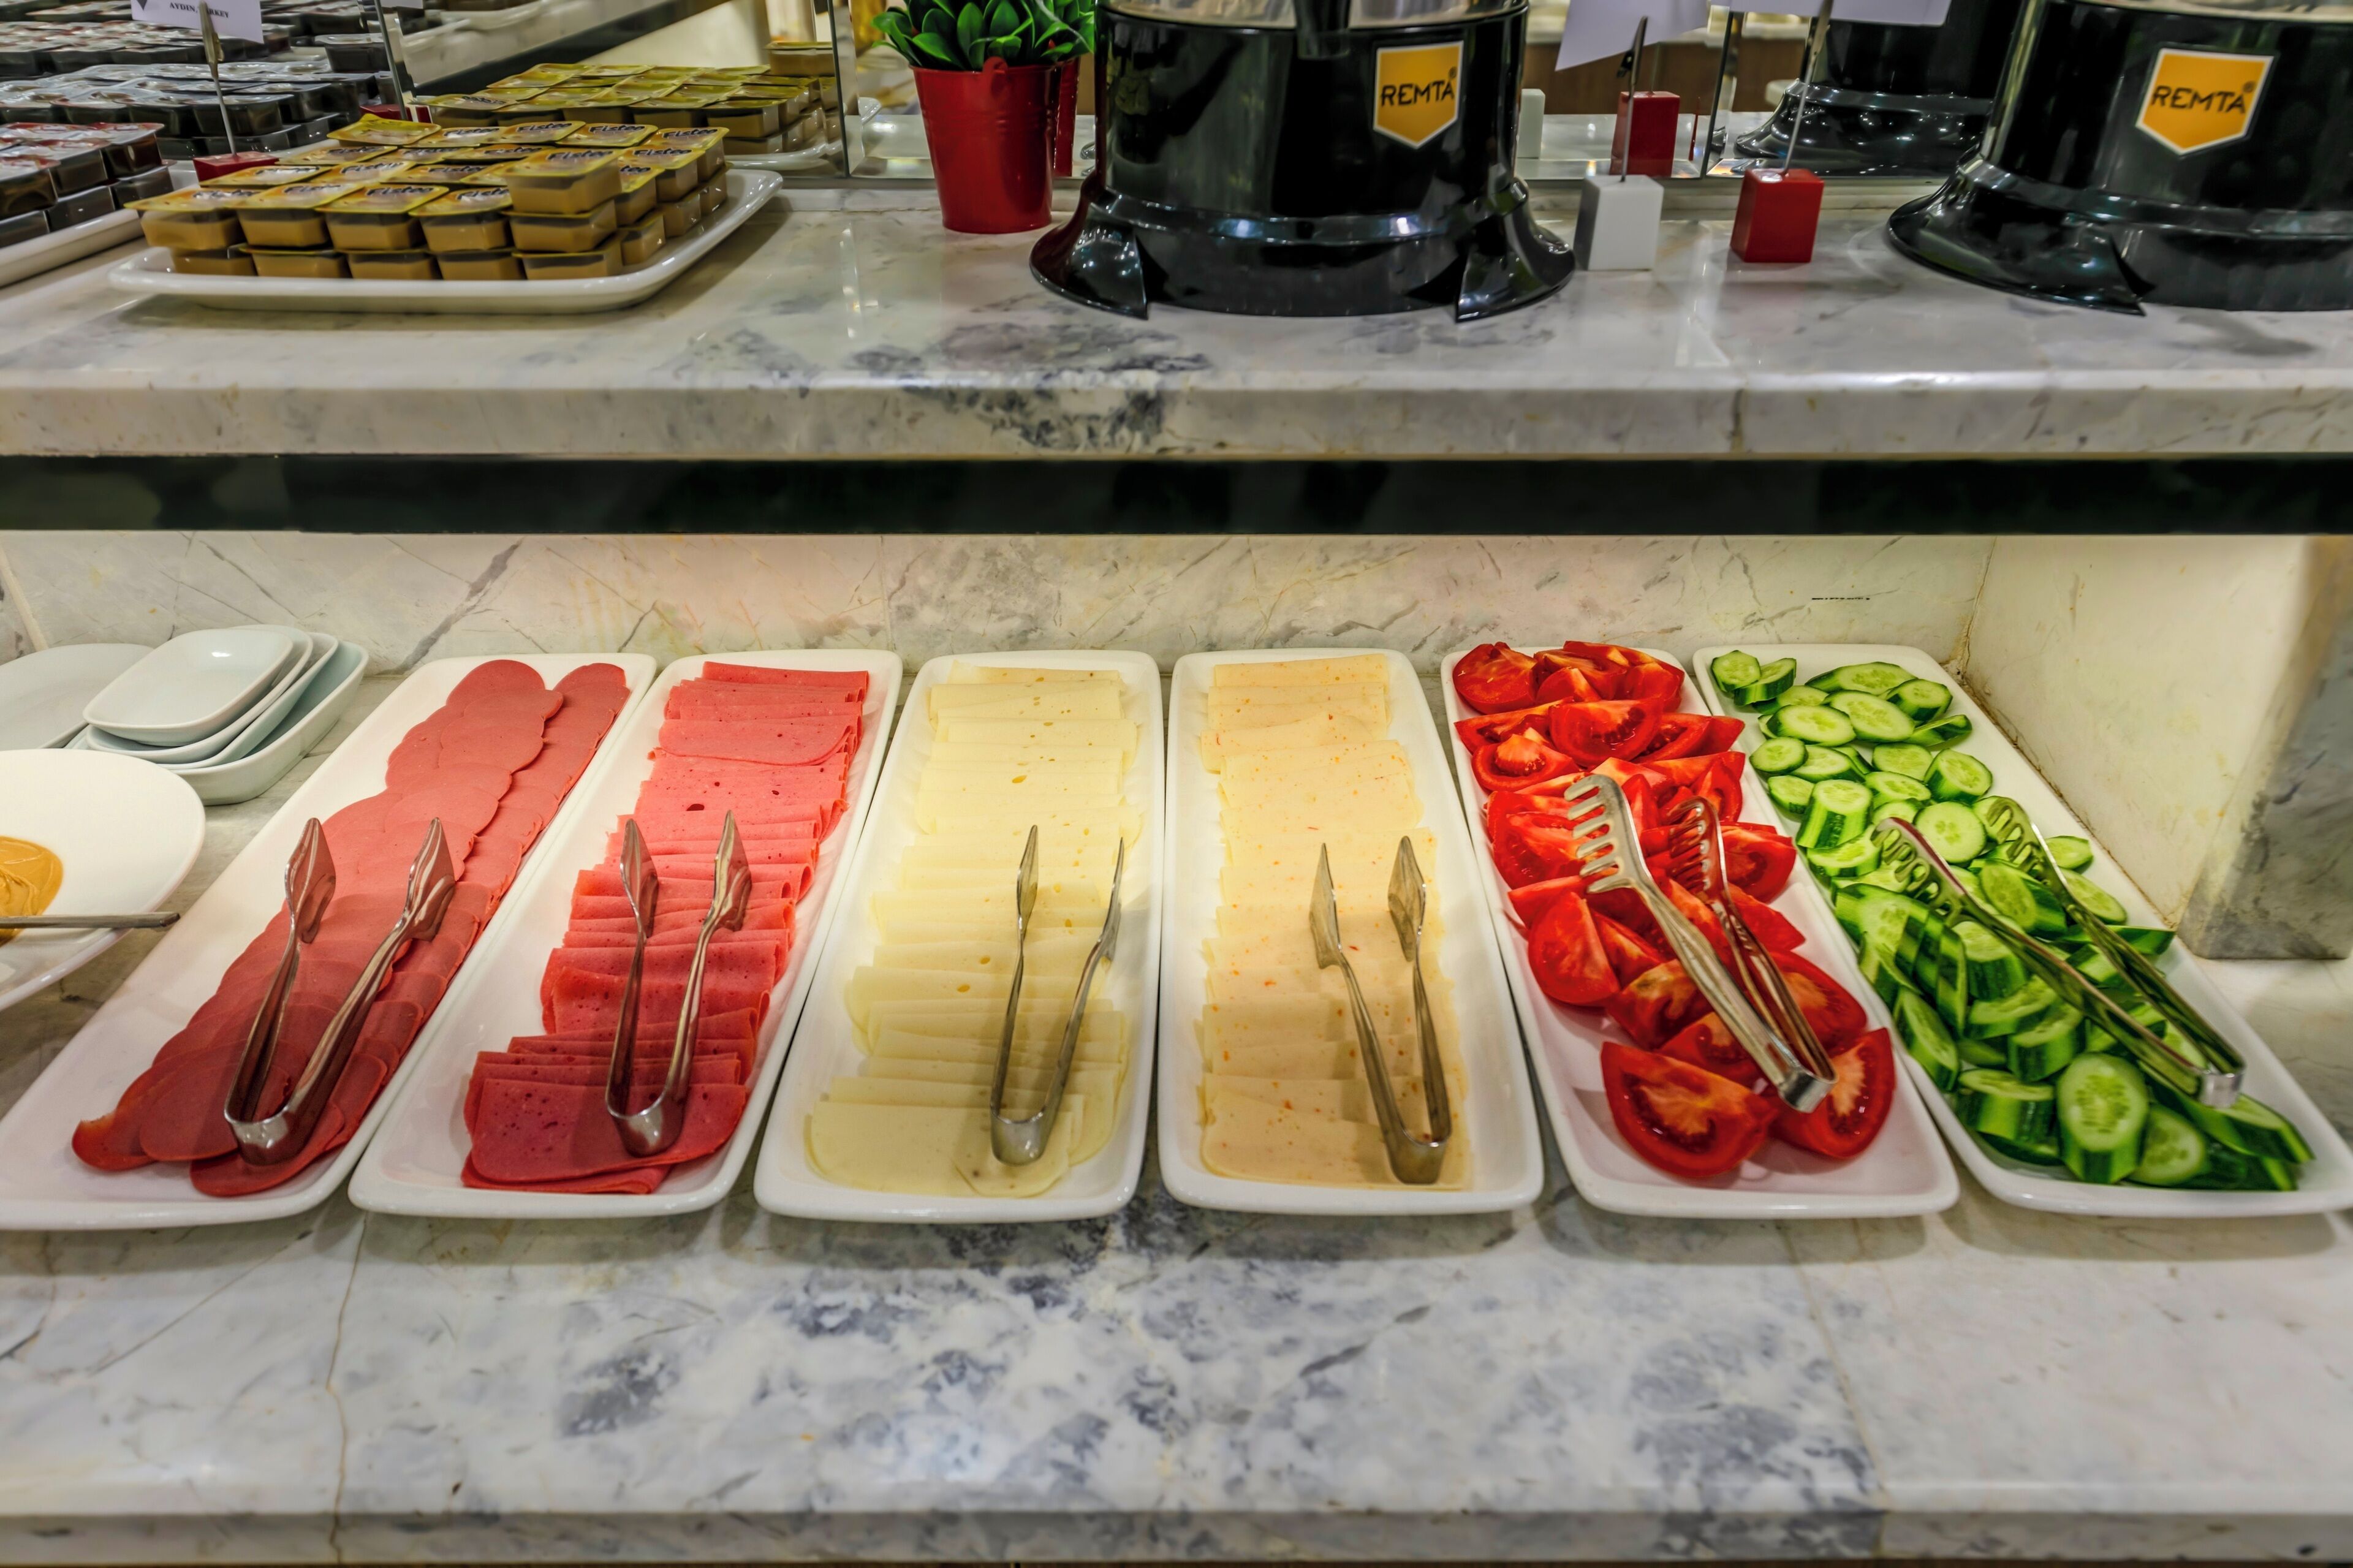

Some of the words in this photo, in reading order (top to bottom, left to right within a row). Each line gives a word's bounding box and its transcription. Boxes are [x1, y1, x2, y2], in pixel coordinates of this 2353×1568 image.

[170, 2, 198, 13] AYDIN,
[206, 8, 229, 18] RKEY
[1381, 80, 1455, 107] REMTA
[2151, 85, 2246, 115] REMTA
